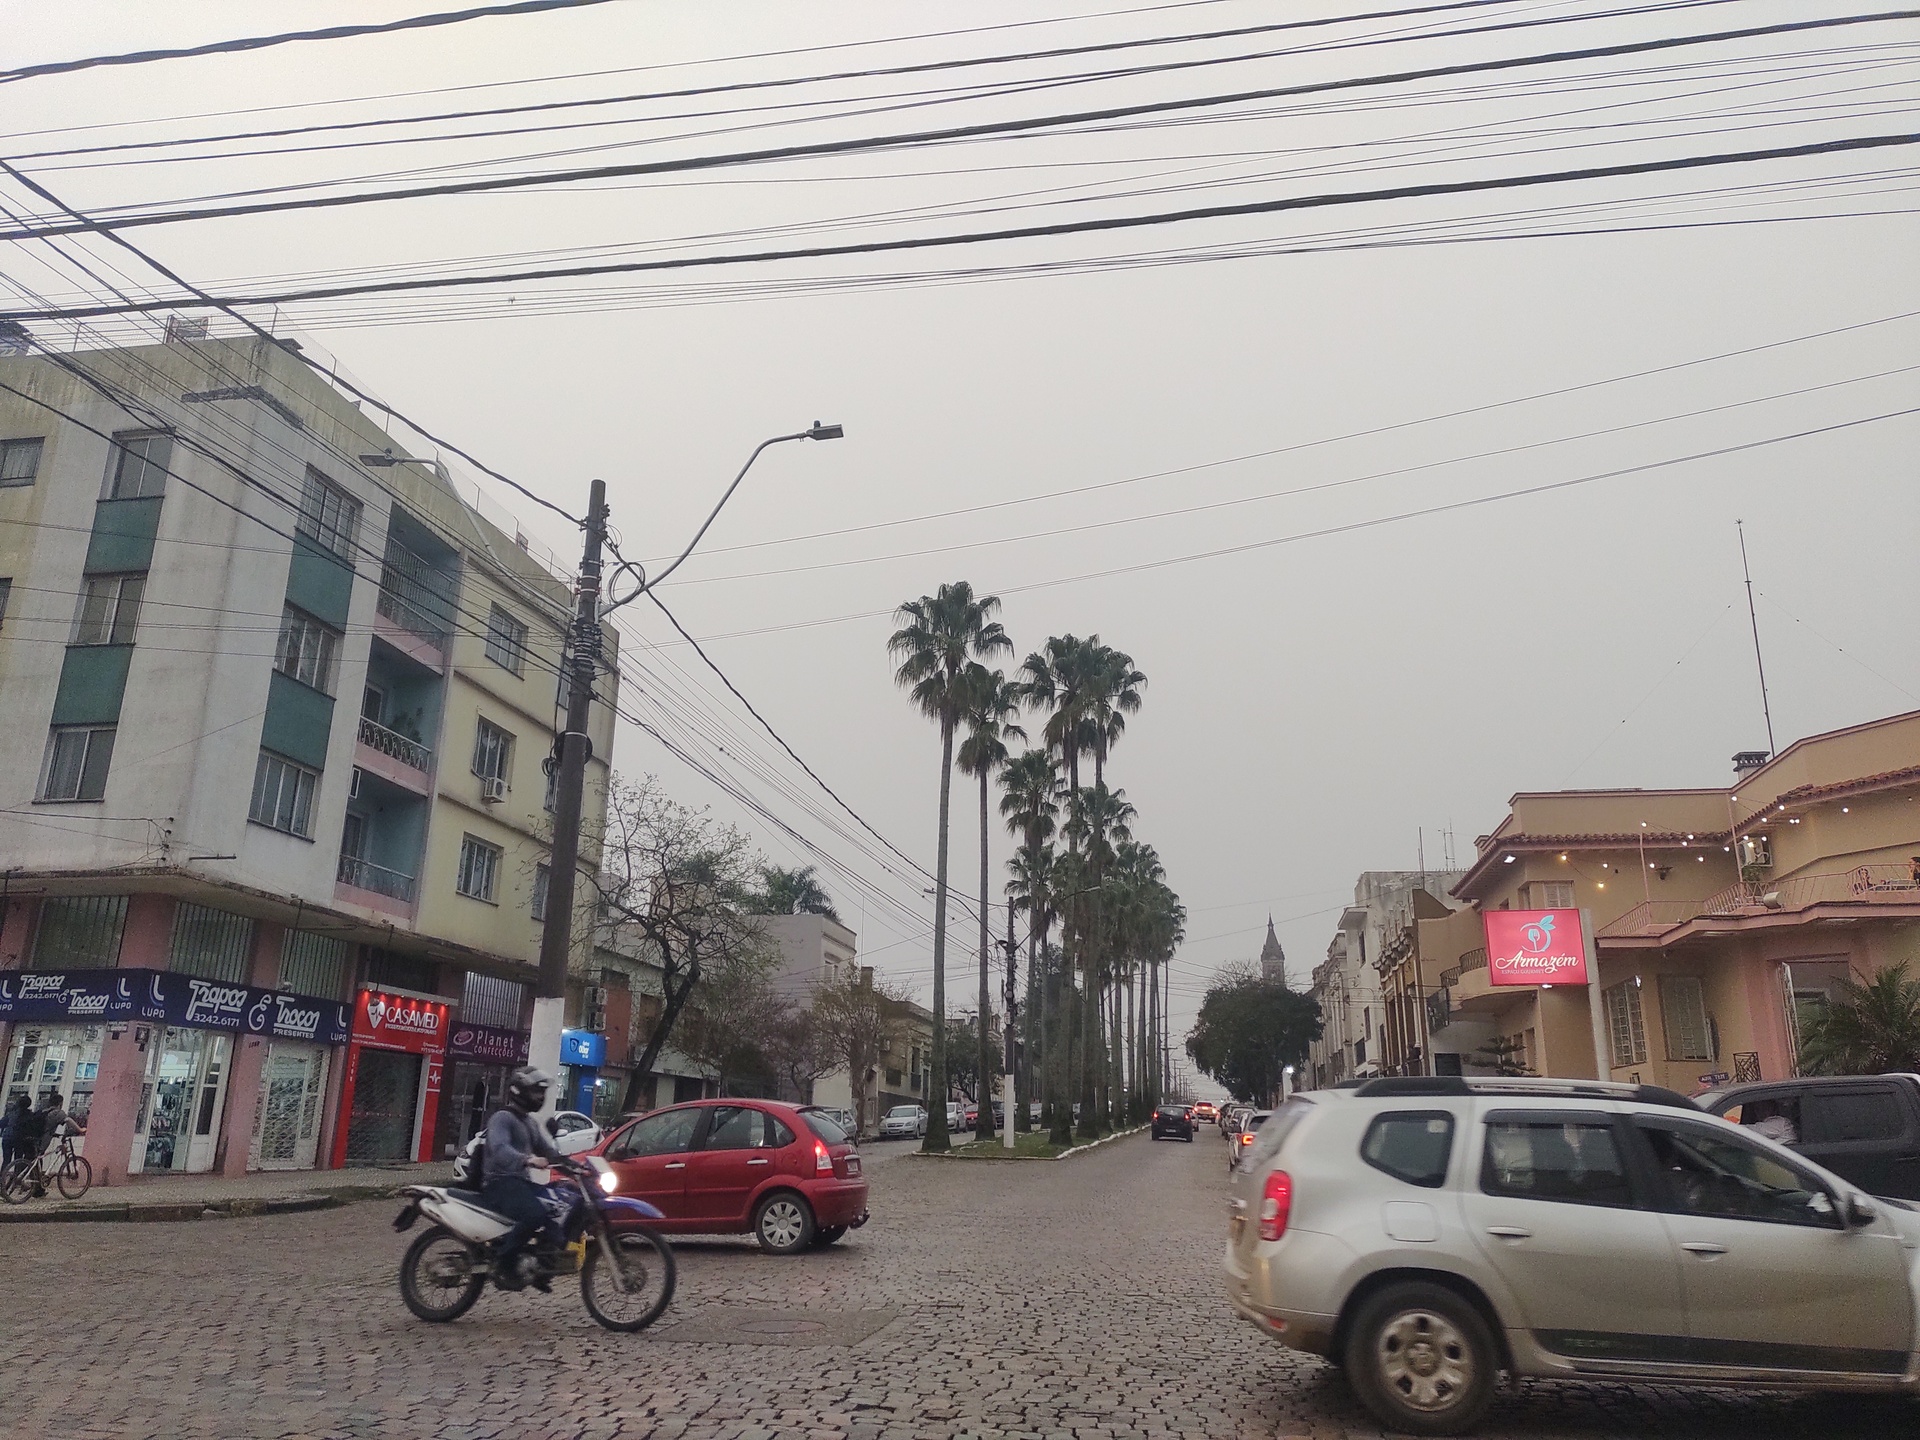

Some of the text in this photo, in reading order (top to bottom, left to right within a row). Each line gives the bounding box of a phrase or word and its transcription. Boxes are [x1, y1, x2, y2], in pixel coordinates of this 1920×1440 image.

[1495, 950, 1579, 974] Armazém
[18, 975, 65, 999] Trapos
[110, 1002, 132, 1010] LUPO
[185, 979, 248, 1021] Trapos
[0, 1003, 13, 1011] PO
[141, 1006, 165, 1018] LUPO
[193, 1013, 240, 1027] 3242.6171
[386, 1006, 439, 1029] CASAMED
[272, 1027, 314, 1039] PRESENTES
[330, 1032, 347, 1042] LUPO
[476, 1030, 514, 1049] Planet
[473, 1045, 514, 1058] CONFECÇÕES
